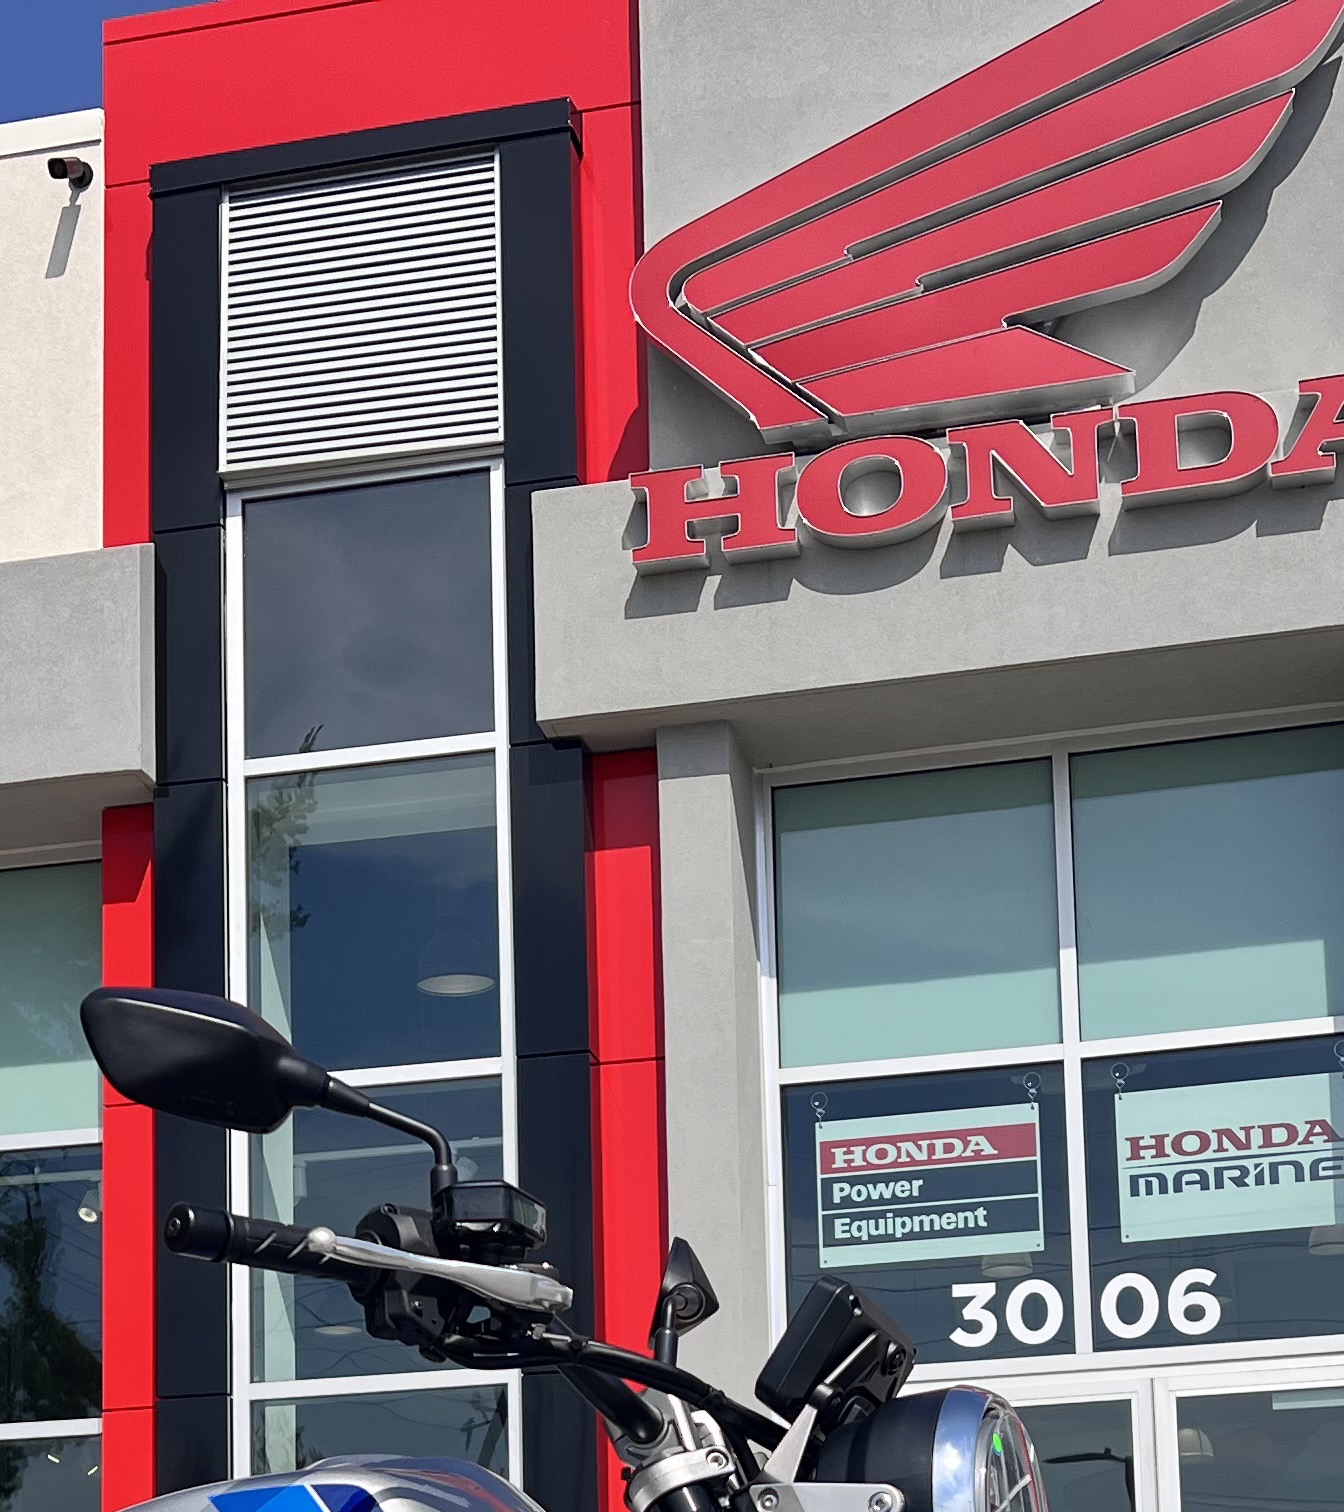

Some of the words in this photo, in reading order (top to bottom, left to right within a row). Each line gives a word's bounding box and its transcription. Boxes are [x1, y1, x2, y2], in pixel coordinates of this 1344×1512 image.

[830, 1134, 999, 1170] HONDA
[1125, 1118, 1344, 1161] HONDA
[832, 1175, 924, 1204] Power
[833, 1206, 988, 1241] Equipment
